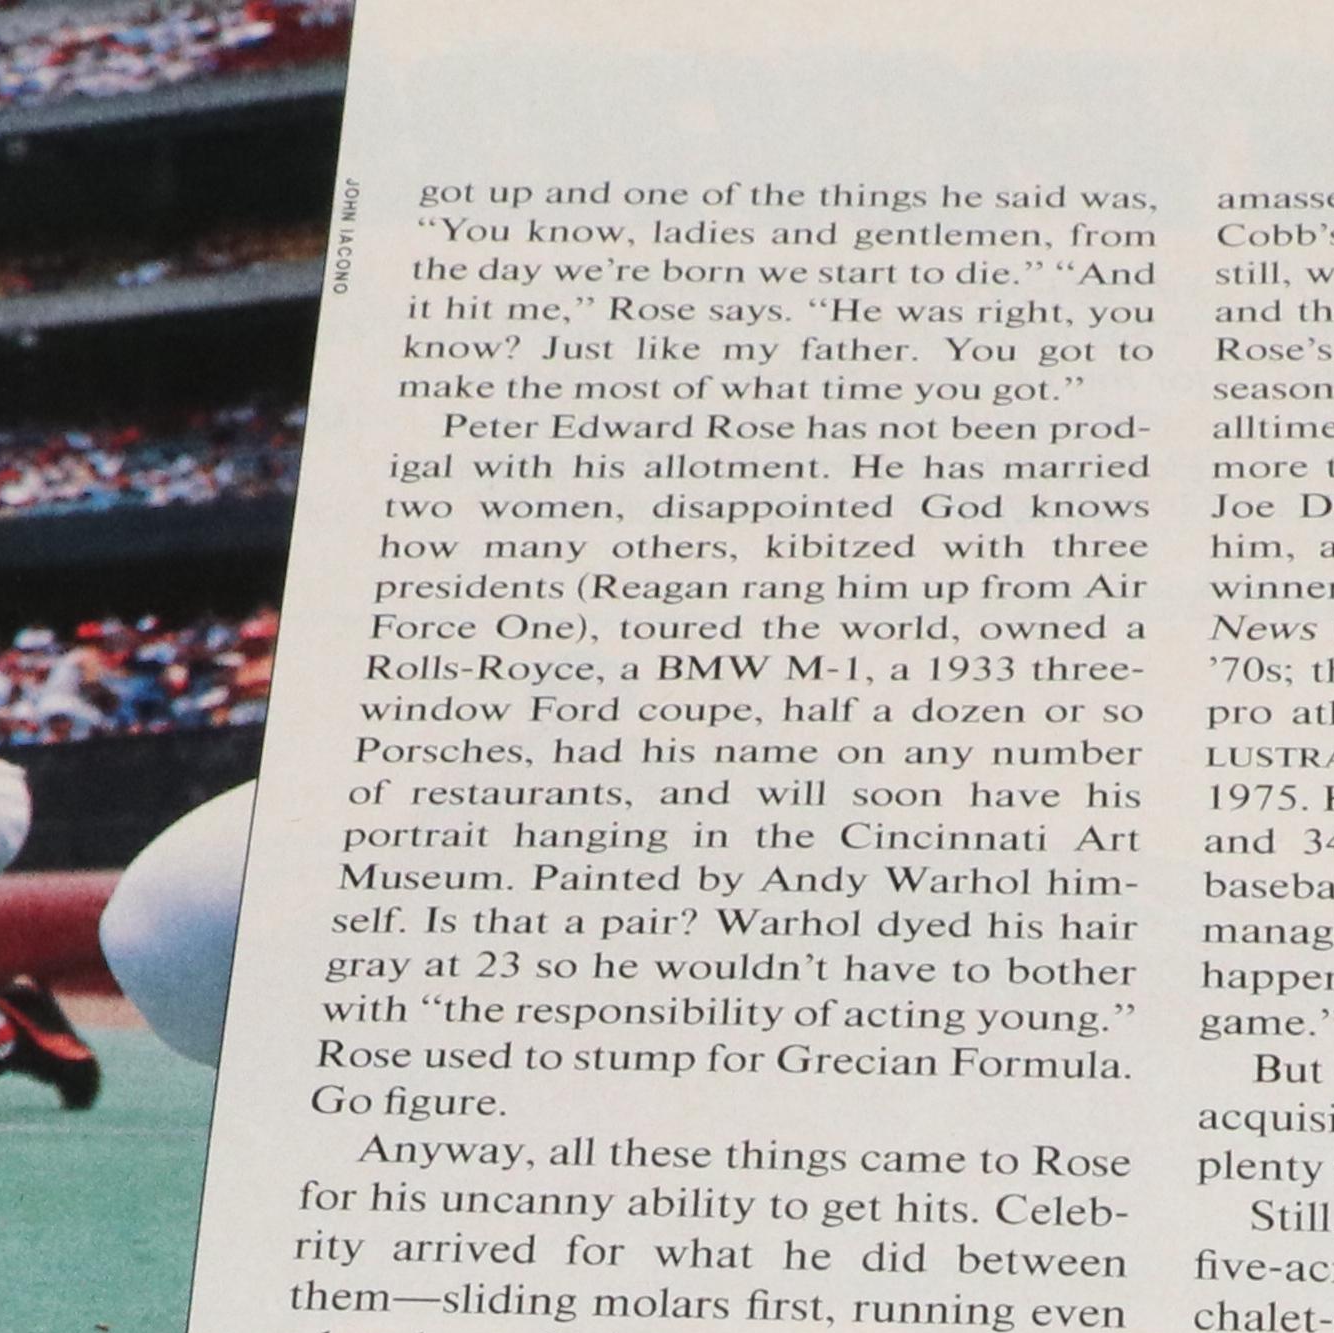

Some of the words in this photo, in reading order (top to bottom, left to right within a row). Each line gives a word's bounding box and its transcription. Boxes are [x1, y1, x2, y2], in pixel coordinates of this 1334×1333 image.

[340, 178, 360, 221] JOHN
[418, 183, 474, 208] got
[489, 186, 533, 209] up
[545, 180, 611, 205] and
[623, 188, 689, 206] one
[702, 181, 742, 206] of
[751, 182, 805, 207] the
[820, 183, 927, 213] things
[942, 184, 983, 209] he
[995, 184, 1066, 209] said
[1080, 192, 1157, 212] was,
[332, 229, 354, 295] IACONO
[1215, 298, 1281, 323] and
[1213, 461, 1308, 479] more
[1210, 614, 1318, 642] News
[365, 654, 605, 687] Rolls-Royce,
[620, 662, 639, 681] a
[657, 654, 771, 681] BMW
[786, 654, 874, 686] M-1,
[890, 663, 909, 682] a
[931, 655, 1015, 682] 1933
[1032, 655, 1144, 682] three-
[348, 778, 392, 805] of
[411, 783, 633, 810] restaurants,
[659, 779, 730, 806] and
[756, 779, 826, 806] will
[852, 787, 942, 807] soon
[970, 780, 1060, 809] have
[1087, 781, 1141, 809] his
[318, 1039, 412, 1069] Rose
[424, 1040, 512, 1070] used
[525, 1045, 563, 1071] to
[574, 1046, 696, 1078] stump
[707, 1042, 766, 1073] for
[776, 1043, 938, 1076] Grecian
[950, 1046, 1132, 1080] Formula.
